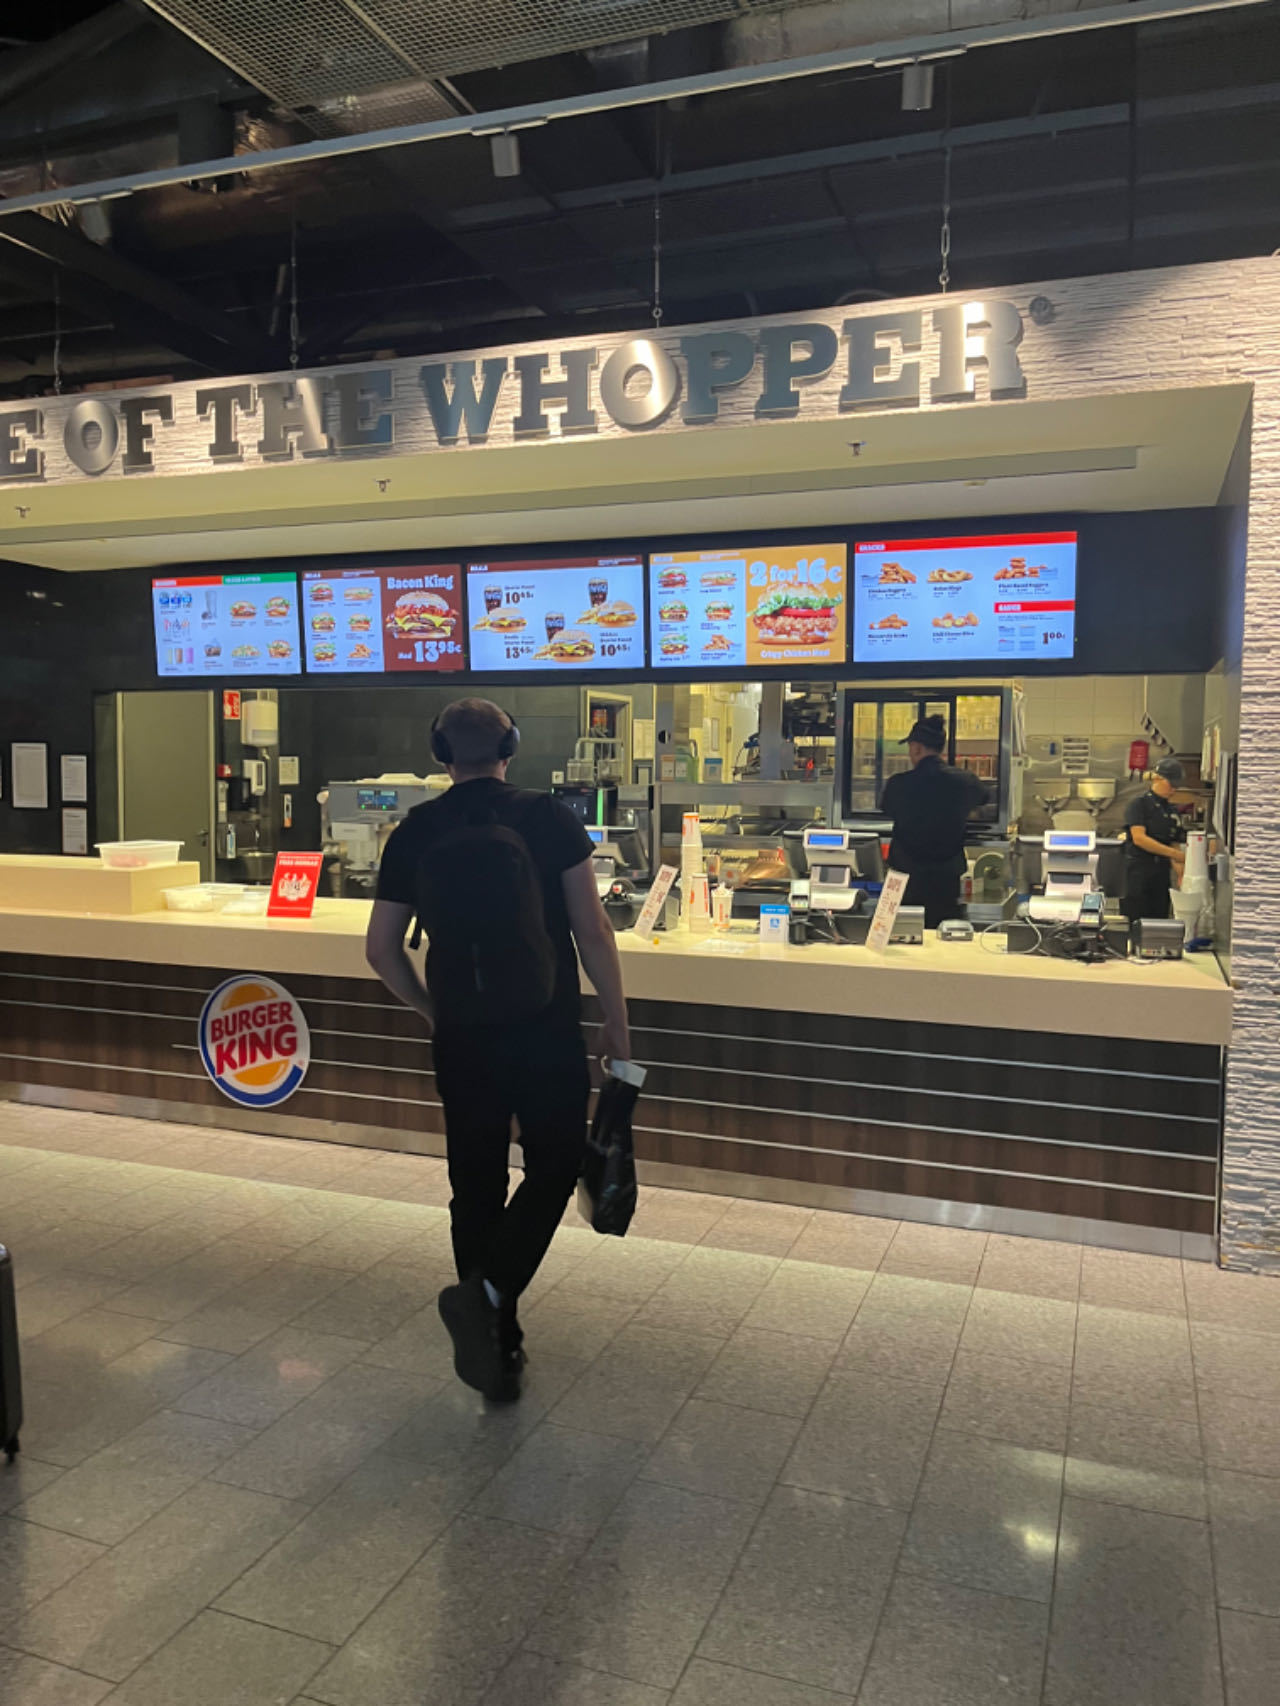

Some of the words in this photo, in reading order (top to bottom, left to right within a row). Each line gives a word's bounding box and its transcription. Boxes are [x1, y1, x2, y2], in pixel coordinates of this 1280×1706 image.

[63, 395, 172, 475] OF
[196, 370, 394, 461] THE
[419, 301, 1026, 444] WHOPPER
[387, 577, 423, 590] Bacon
[424, 574, 454, 590] King
[749, 561, 767, 587] 2
[770, 564, 796, 582] for
[211, 1002, 293, 1043] BURGER
[215, 1024, 297, 1075] KING
